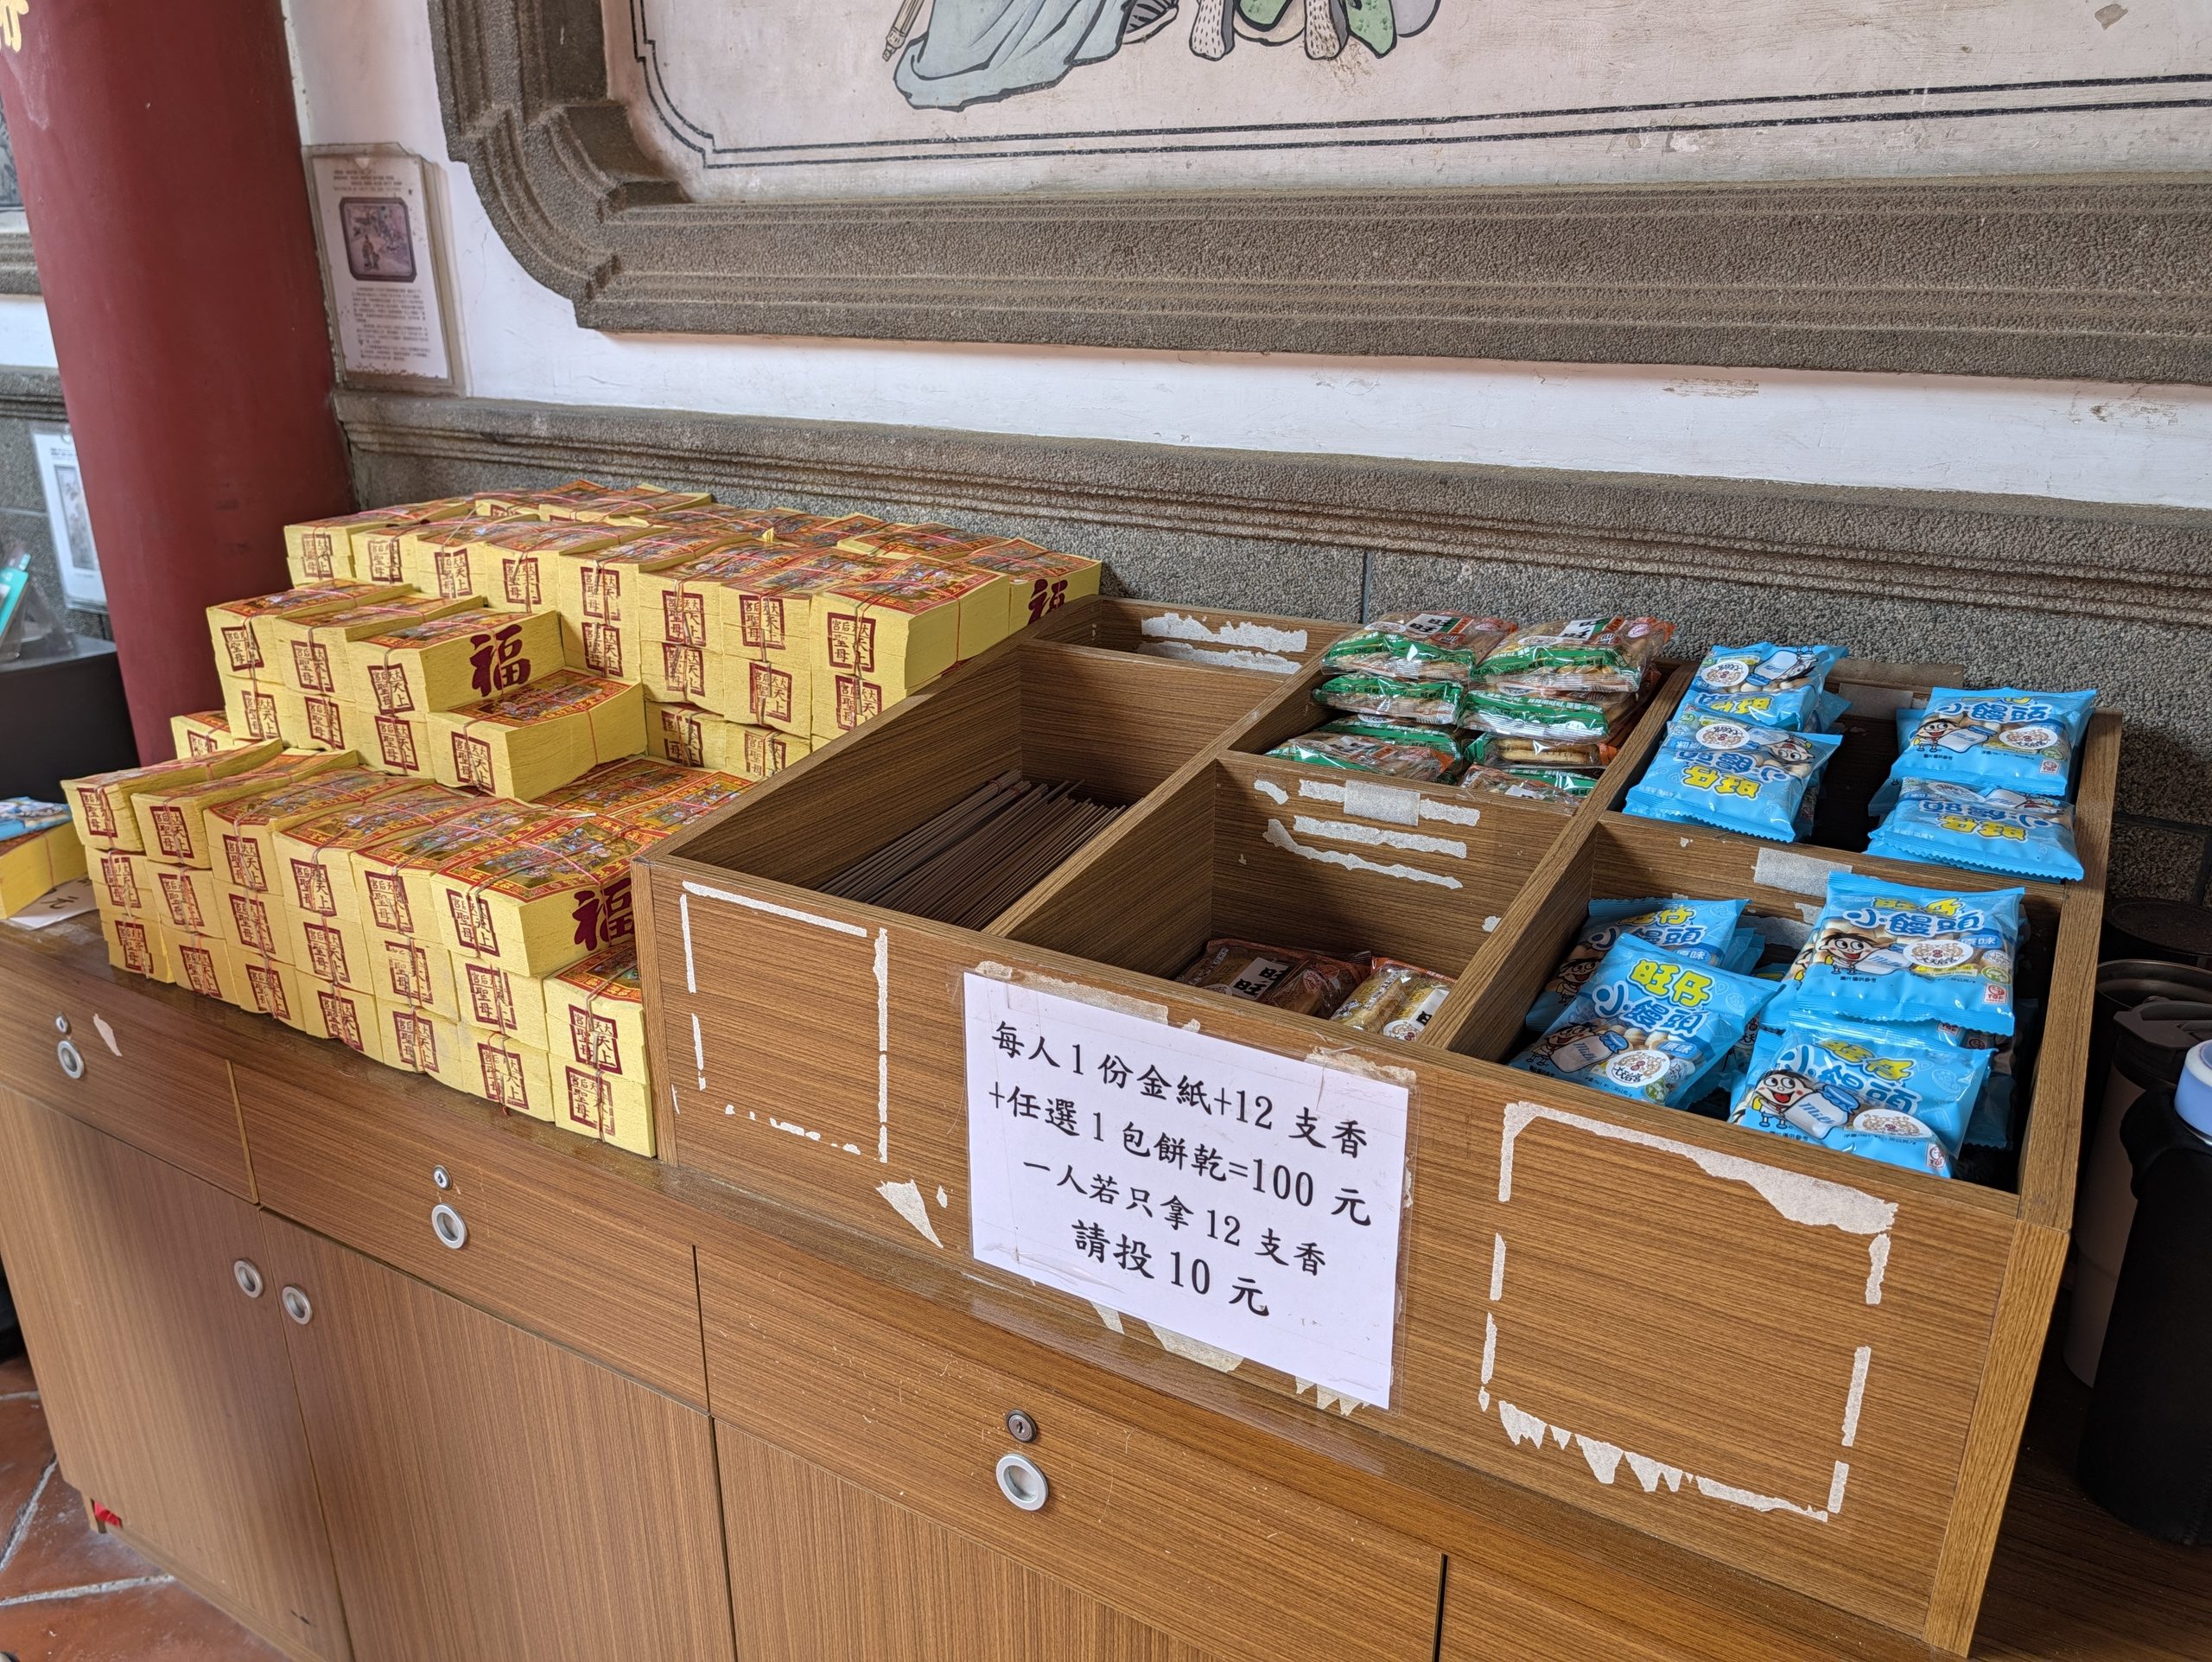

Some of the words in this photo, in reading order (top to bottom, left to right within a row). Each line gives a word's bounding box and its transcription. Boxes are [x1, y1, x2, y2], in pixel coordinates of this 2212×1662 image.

[470, 624, 531, 697] 福
[571, 877, 634, 951] 福
[1846, 909, 1982, 936] 小饅頭
[1630, 959, 1713, 1007] 旺仔
[1598, 984, 1703, 1034] 小饅頭
[1661, 1042, 1694, 1054] 原味
